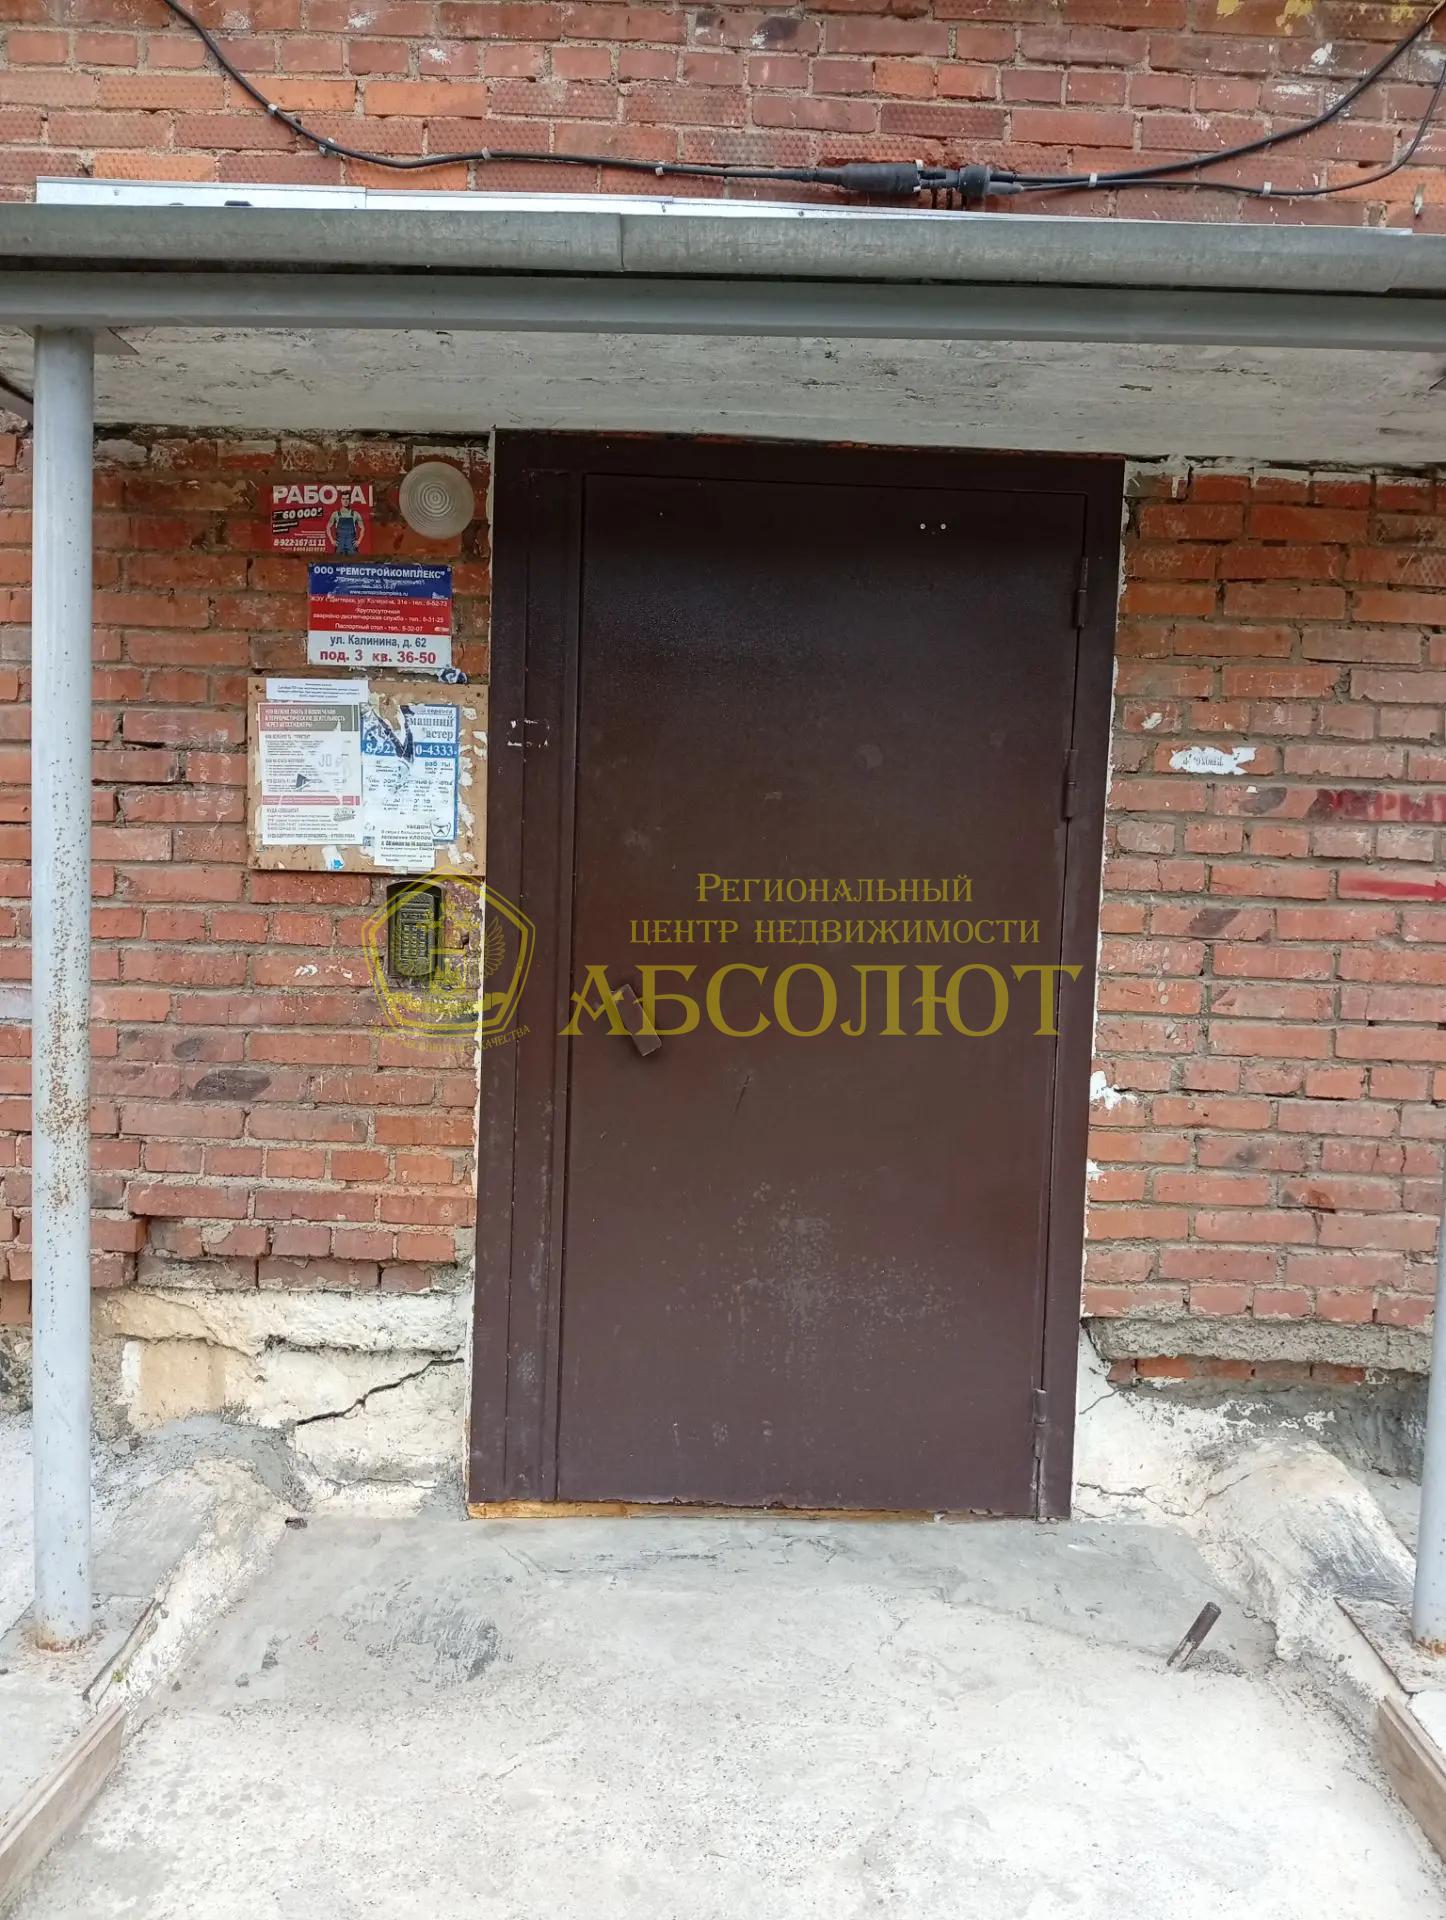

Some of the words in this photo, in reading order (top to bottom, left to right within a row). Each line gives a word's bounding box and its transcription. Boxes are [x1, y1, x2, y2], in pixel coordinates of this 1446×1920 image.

[313, 566, 334, 575] ООО
[335, 622, 370, 630] Паспортный
[329, 636, 345, 647] ул.
[348, 634, 400, 648] Калинина,
[402, 638, 412, 648] д.
[415, 637, 427, 648] 62
[319, 650, 350, 663] под.
[355, 649, 363, 662] 3
[372, 652, 393, 663] кв.
[397, 651, 436, 665] 36-50
